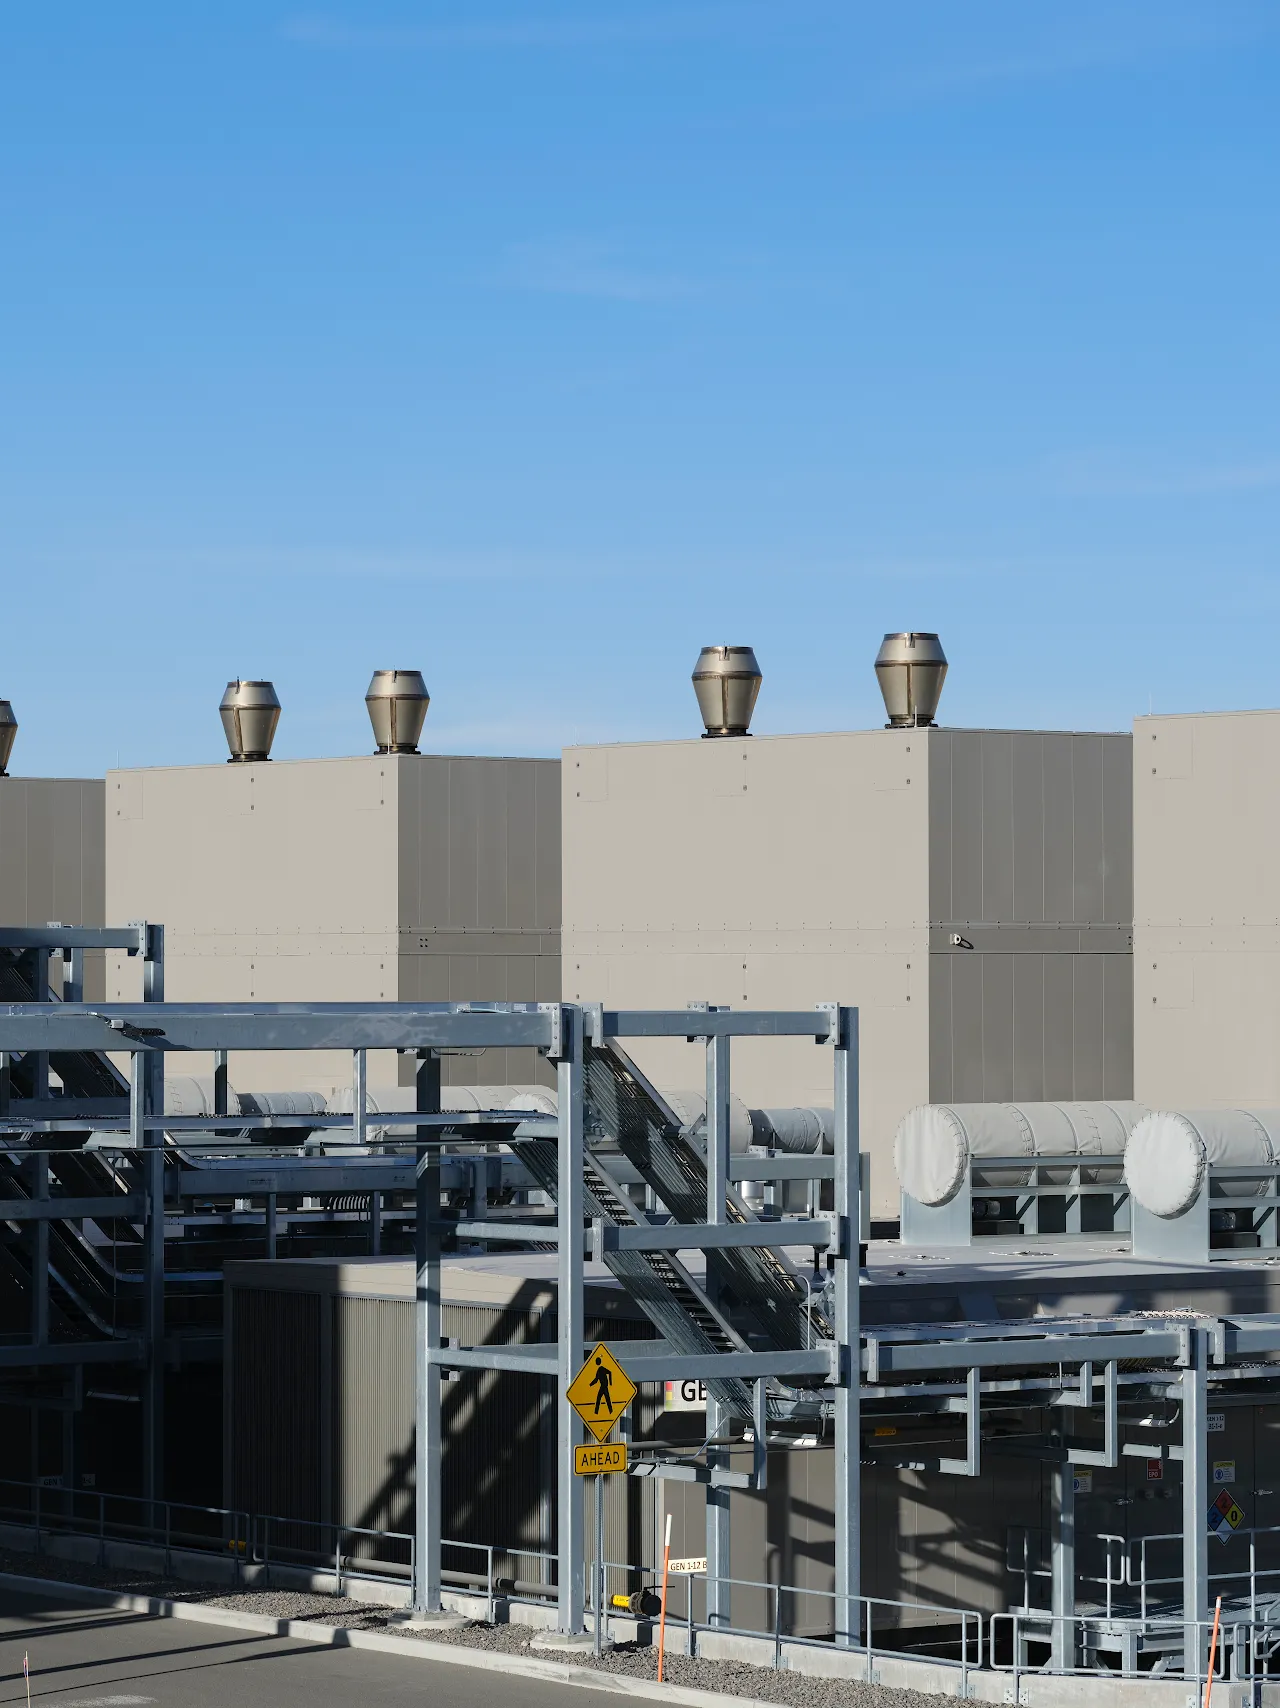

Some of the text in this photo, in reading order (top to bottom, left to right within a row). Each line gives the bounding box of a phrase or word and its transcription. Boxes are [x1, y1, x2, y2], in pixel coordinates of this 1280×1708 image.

[581, 1451, 620, 1467] AHEAD
[1211, 1512, 1218, 1523] 2
[1230, 1510, 1238, 1522] 0
[670, 1562, 685, 1571] GEN
[687, 1561, 701, 1570] 1-12
